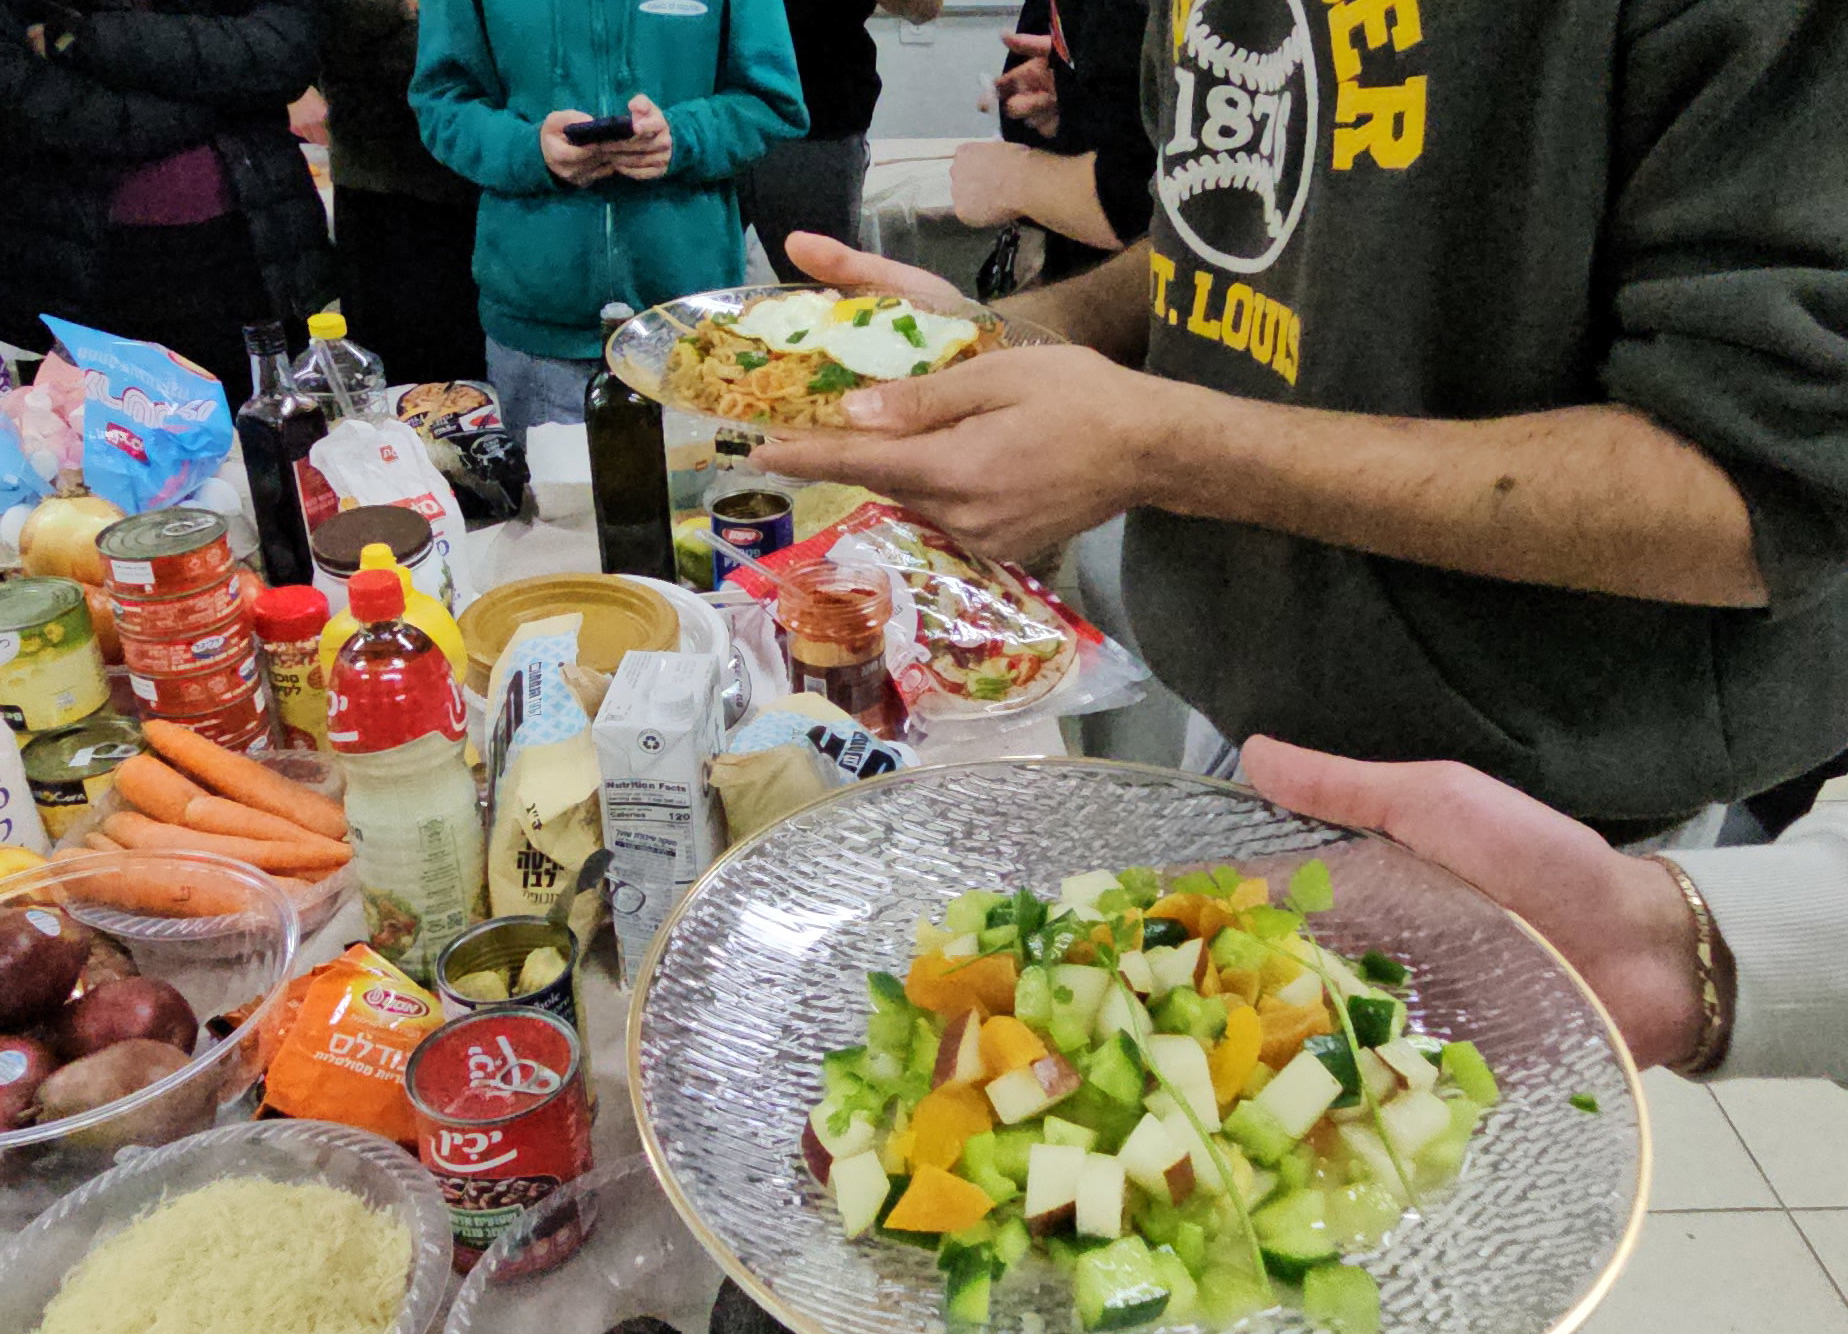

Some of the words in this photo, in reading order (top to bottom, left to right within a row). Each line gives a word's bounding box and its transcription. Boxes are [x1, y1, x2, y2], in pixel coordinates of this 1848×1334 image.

[1149, 246, 1178, 326] T.
[1186, 270, 1301, 387] LOUIS
[605, 780, 655, 789] Nutrition
[658, 782, 687, 792] Facts
[609, 810, 646, 818] Calories
[668, 812, 690, 821] 120
[522, 867, 558, 889] לבן
[440, 1130, 503, 1161] יכין
